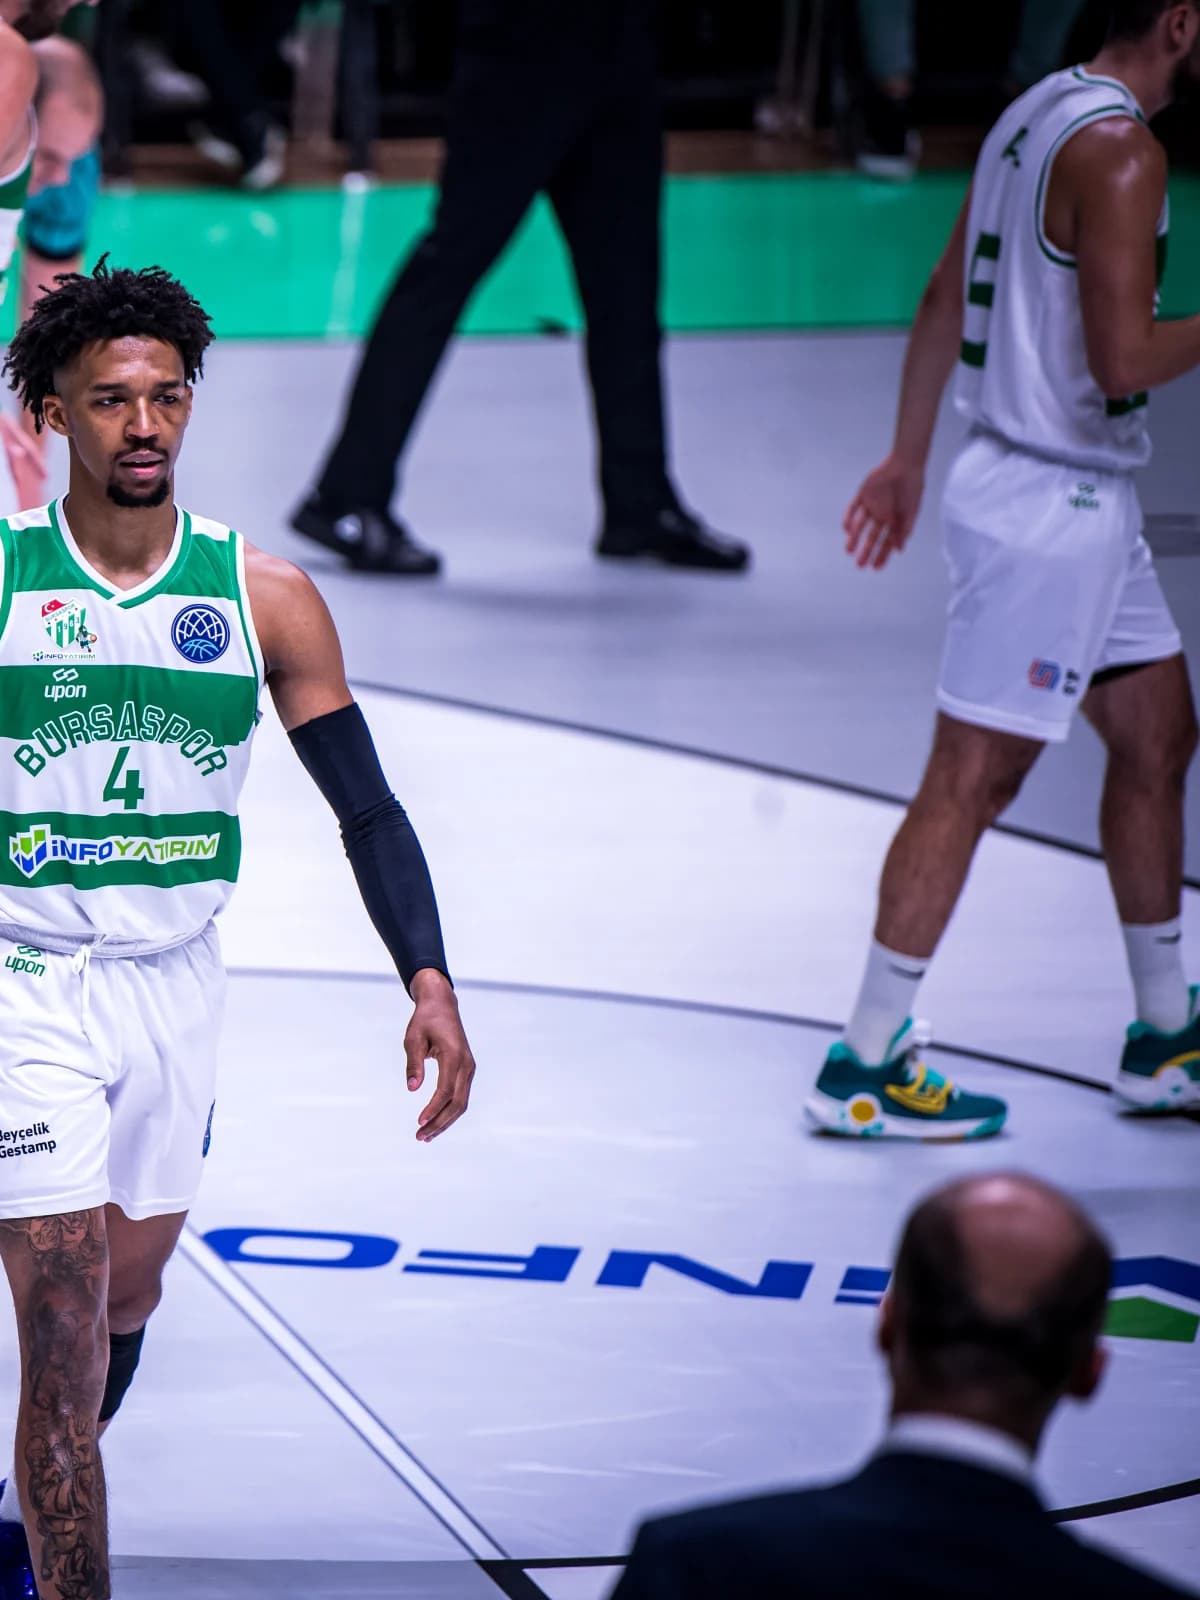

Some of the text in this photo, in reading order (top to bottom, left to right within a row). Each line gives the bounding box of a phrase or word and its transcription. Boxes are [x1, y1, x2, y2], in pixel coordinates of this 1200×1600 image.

[44, 684, 87, 702] upon
[13, 701, 228, 778] BURSASPOR
[102, 746, 145, 810] 4
[4, 955, 46, 977] upon
